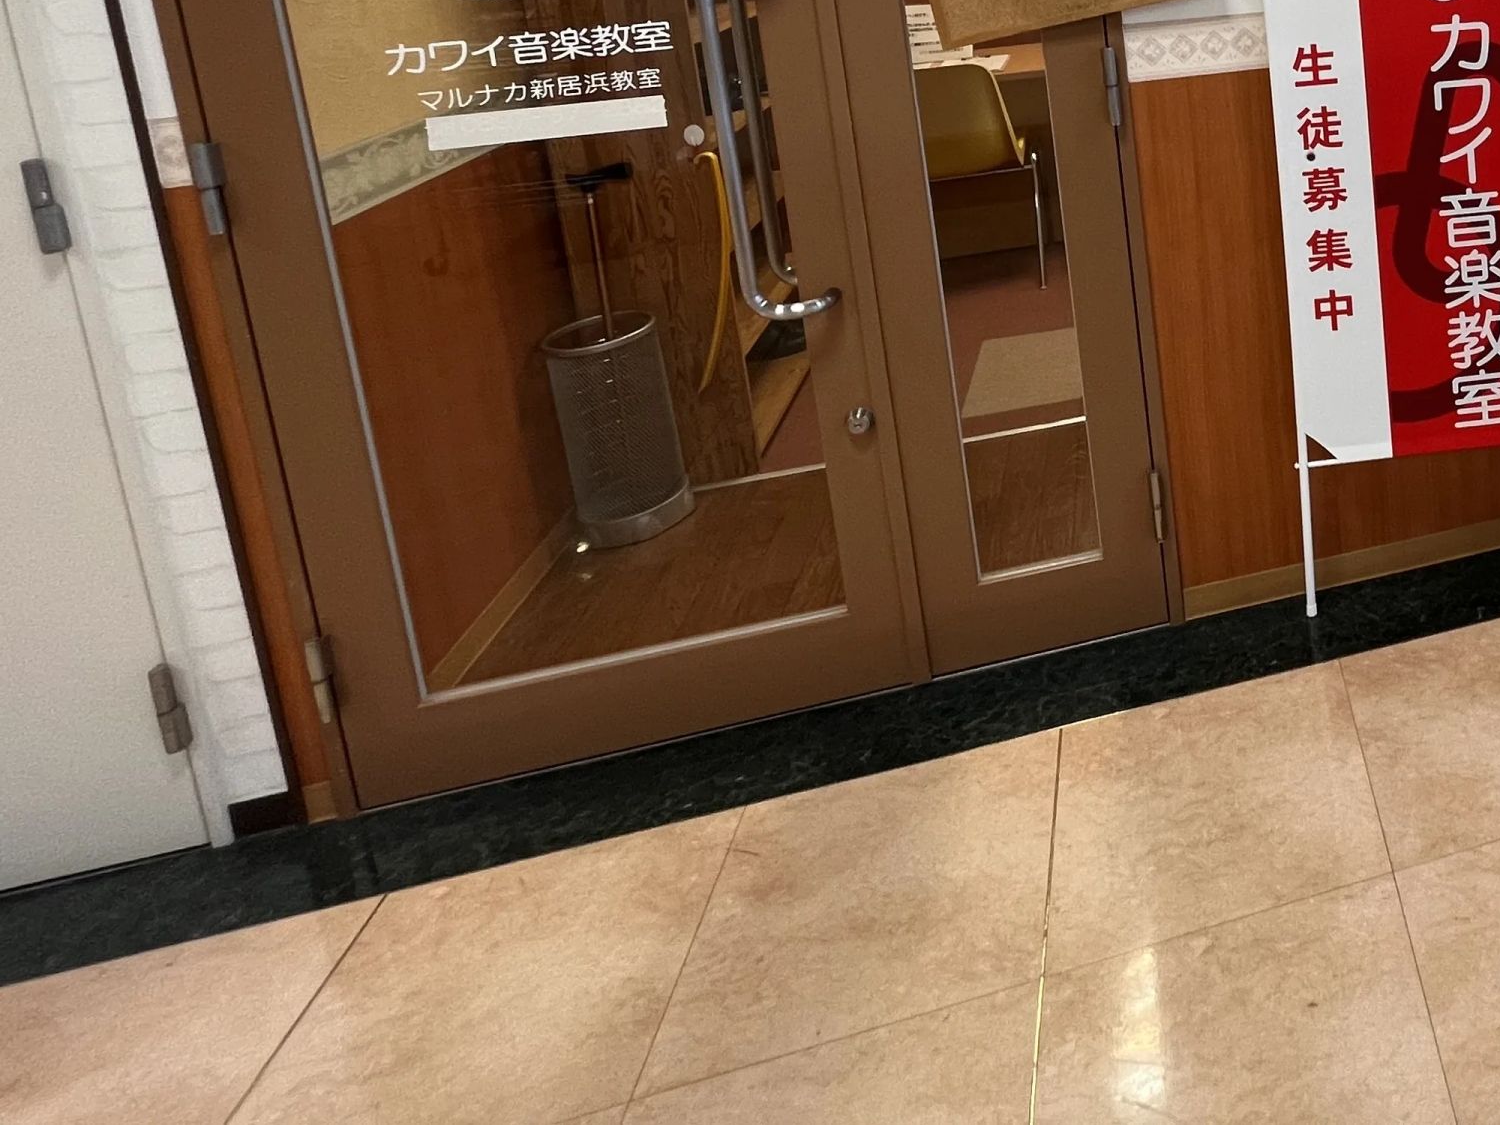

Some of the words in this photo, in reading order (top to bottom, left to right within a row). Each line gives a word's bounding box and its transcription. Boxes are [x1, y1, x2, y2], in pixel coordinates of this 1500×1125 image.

[384, 20, 674, 76] カワイ音楽教室
[417, 67, 662, 111] マルナカ新居浜教室
[1292, 44, 1354, 332] 生徒募集中
